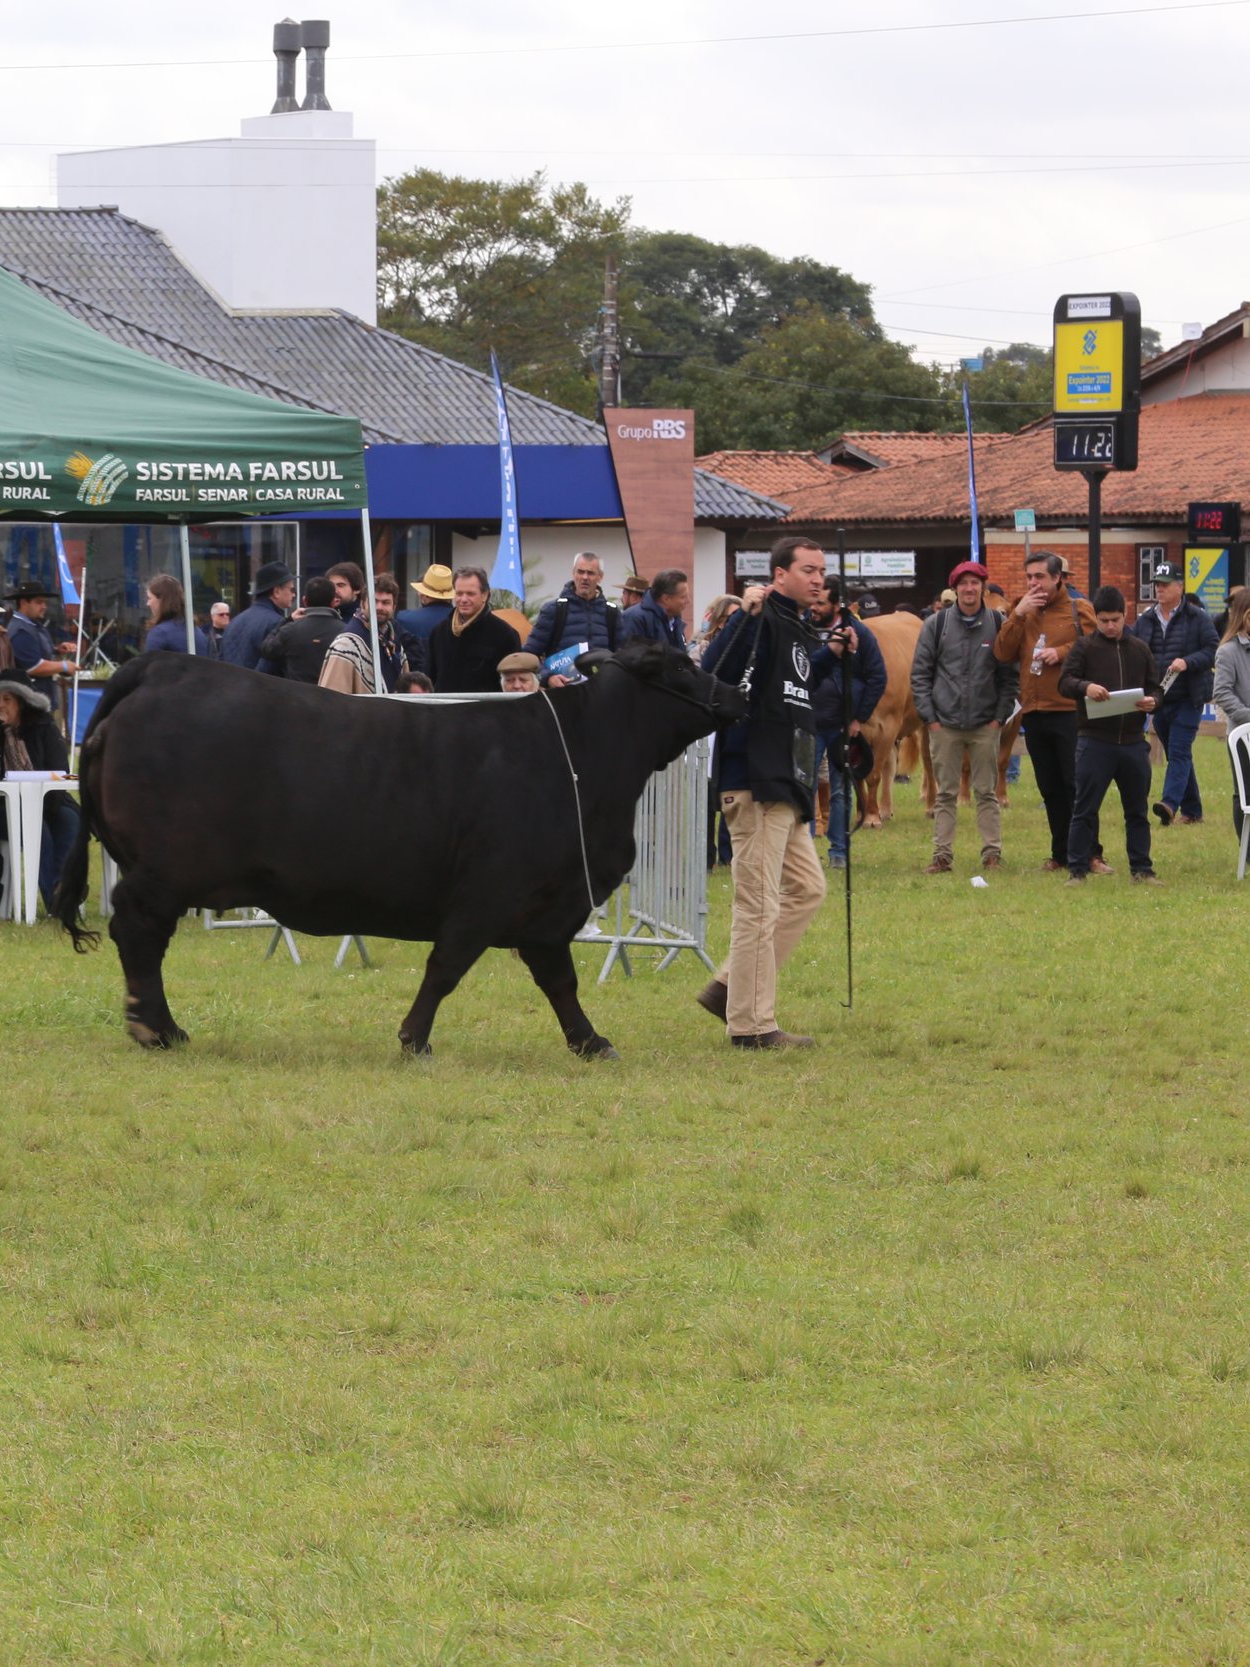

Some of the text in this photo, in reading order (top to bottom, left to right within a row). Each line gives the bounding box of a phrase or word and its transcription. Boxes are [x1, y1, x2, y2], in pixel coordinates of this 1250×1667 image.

[1069, 302, 1098, 310] EXPOINTER
[1069, 375, 1095, 387] Expointer
[617, 419, 686, 441] Grupo RBS
[136, 460, 344, 482] SISTEMA FARSUL
[2, 486, 50, 500] RURAL
[136, 487, 344, 502] FARSUL SENAR CASA RURAL
[1196, 511, 1223, 529] 11:22
